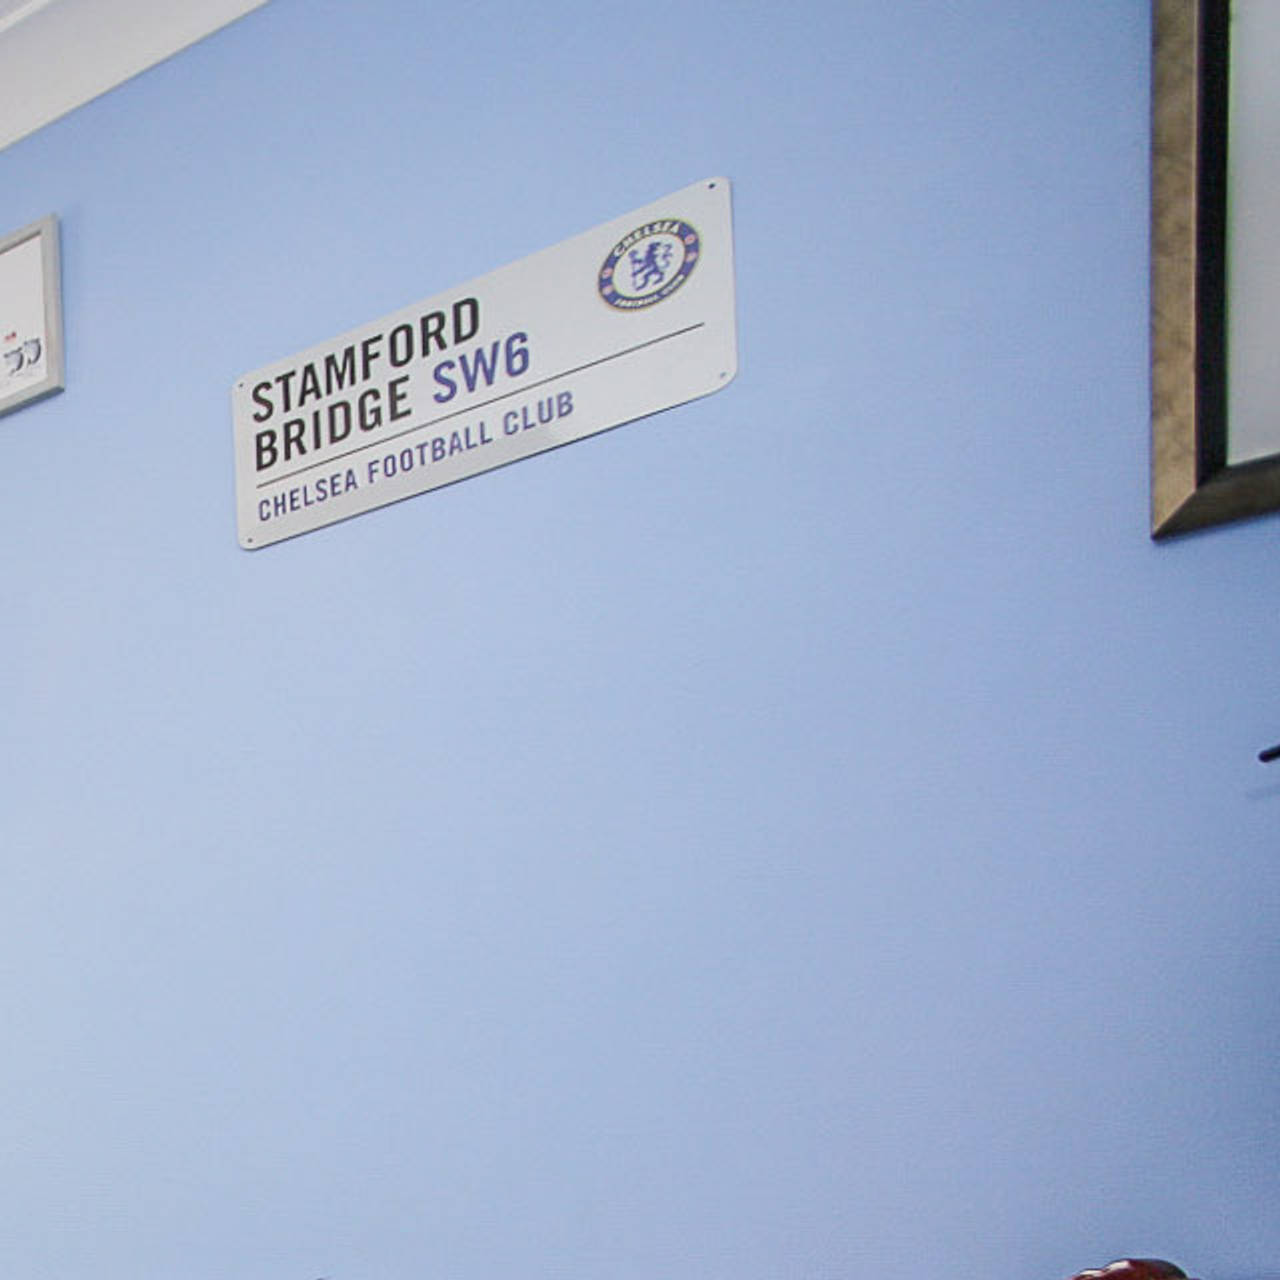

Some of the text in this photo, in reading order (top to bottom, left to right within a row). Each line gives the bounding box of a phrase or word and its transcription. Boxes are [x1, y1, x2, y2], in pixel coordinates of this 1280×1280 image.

[251, 297, 480, 424] STAMFORD
[255, 331, 530, 473] BRIDGE SW6
[258, 391, 574, 522] CHELSEA FOOTBALL CLUB
